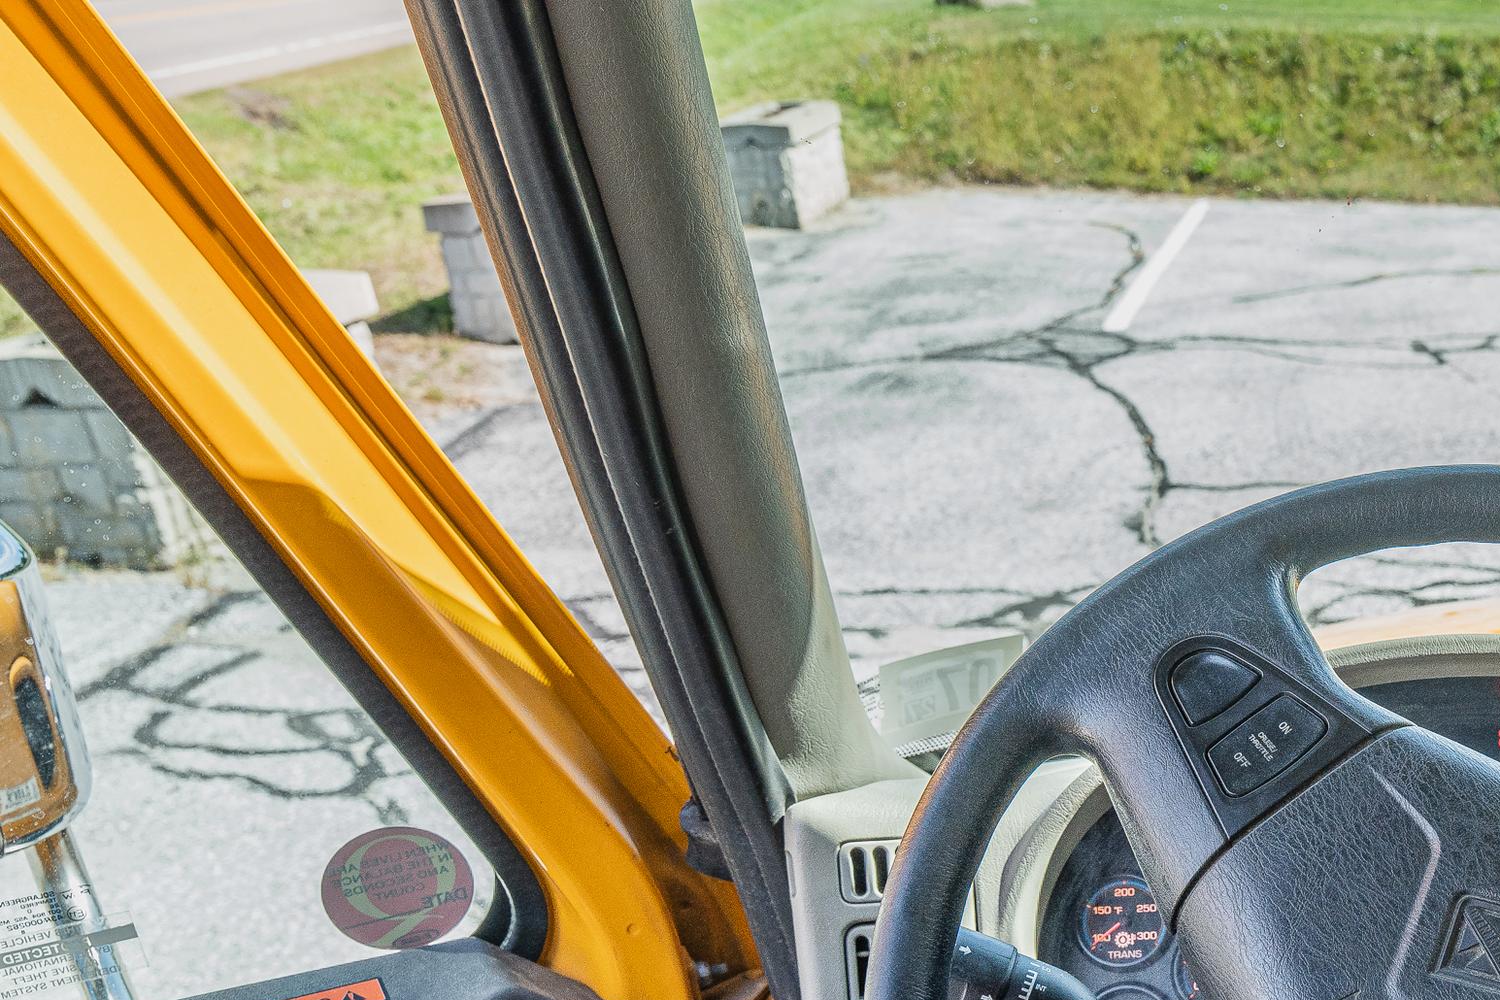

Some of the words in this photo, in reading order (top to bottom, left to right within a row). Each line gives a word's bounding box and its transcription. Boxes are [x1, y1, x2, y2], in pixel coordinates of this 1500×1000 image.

[1279, 721, 1292, 735] ON
[1248, 734, 1273, 762] THROTTLE
[1114, 888, 1135, 897] 200
[1093, 905, 1111, 914] 150
[1136, 904, 1156, 913] 250
[1137, 931, 1157, 940] 300
[1108, 950, 1142, 958] TRANS
